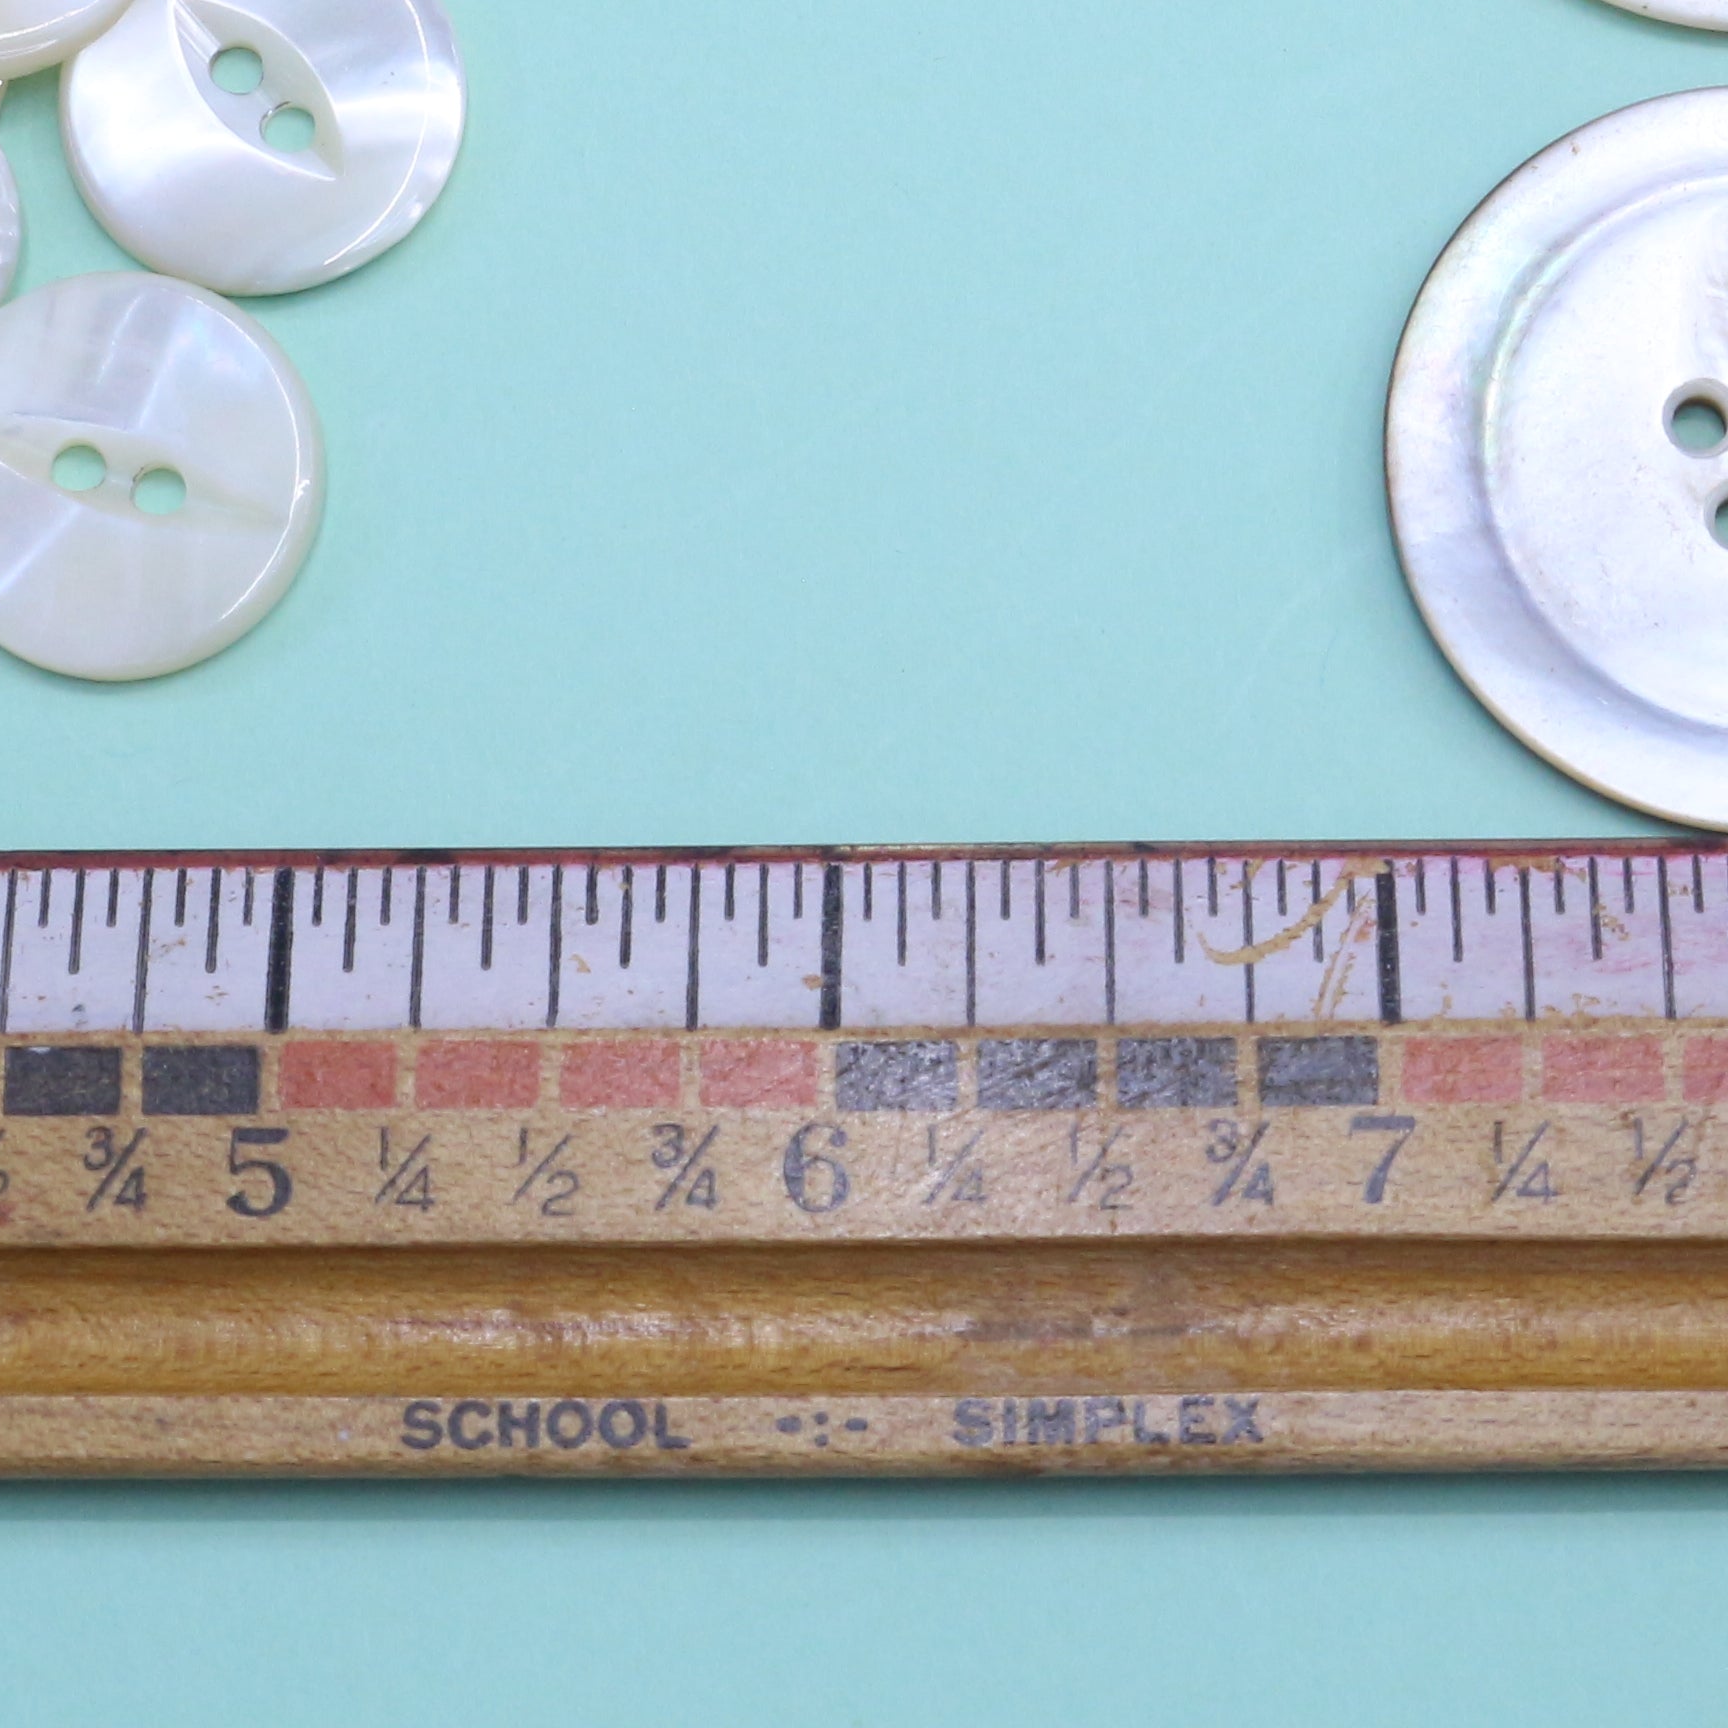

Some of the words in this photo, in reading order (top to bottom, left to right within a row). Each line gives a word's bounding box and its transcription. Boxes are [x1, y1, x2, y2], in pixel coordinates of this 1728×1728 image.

[226, 1127, 294, 1218] 5
[783, 1122, 850, 1213] 6
[1349, 1115, 1417, 1205] 7
[400, 1399, 693, 1451] SCHOOL
[952, 1397, 1265, 1449] SIMPLEX
